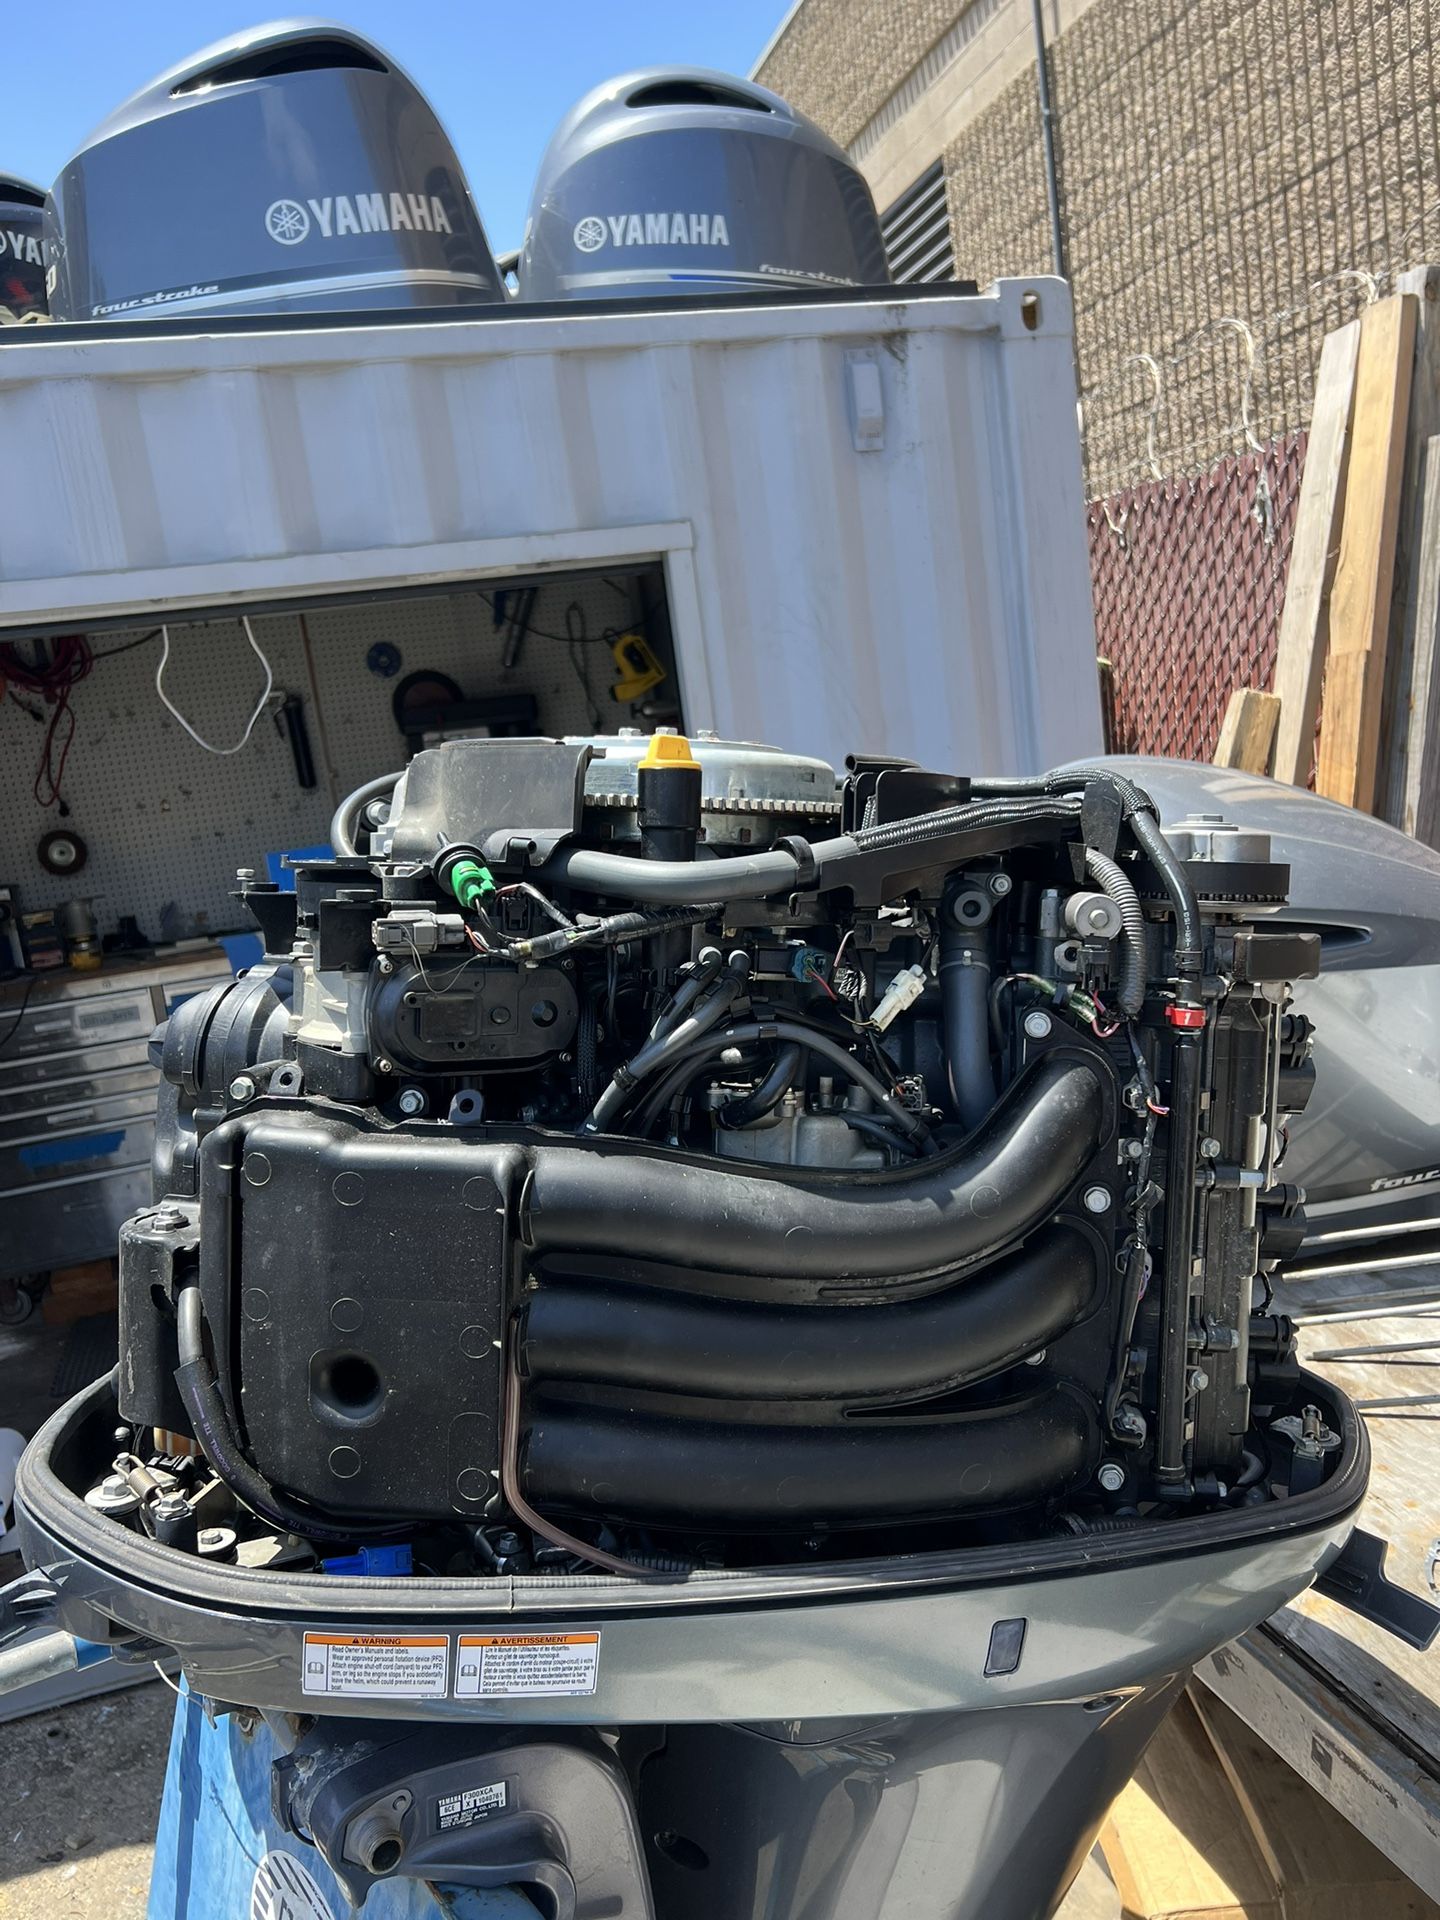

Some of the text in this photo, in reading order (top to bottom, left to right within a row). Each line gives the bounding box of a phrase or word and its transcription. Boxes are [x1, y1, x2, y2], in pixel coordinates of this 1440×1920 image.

[307, 192, 453, 237] YAMAHA
[607, 213, 730, 247] YAMAHA
[500, 1636, 568, 1644] AVERTISSEMENT
[352, 1654, 374, 1662] approved
[374, 1654, 394, 1662] personal
[348, 1662, 363, 1670] engine
[416, 1671, 444, 1679] accidentally
[439, 1787, 493, 1806] YAMAHA F300XCA
